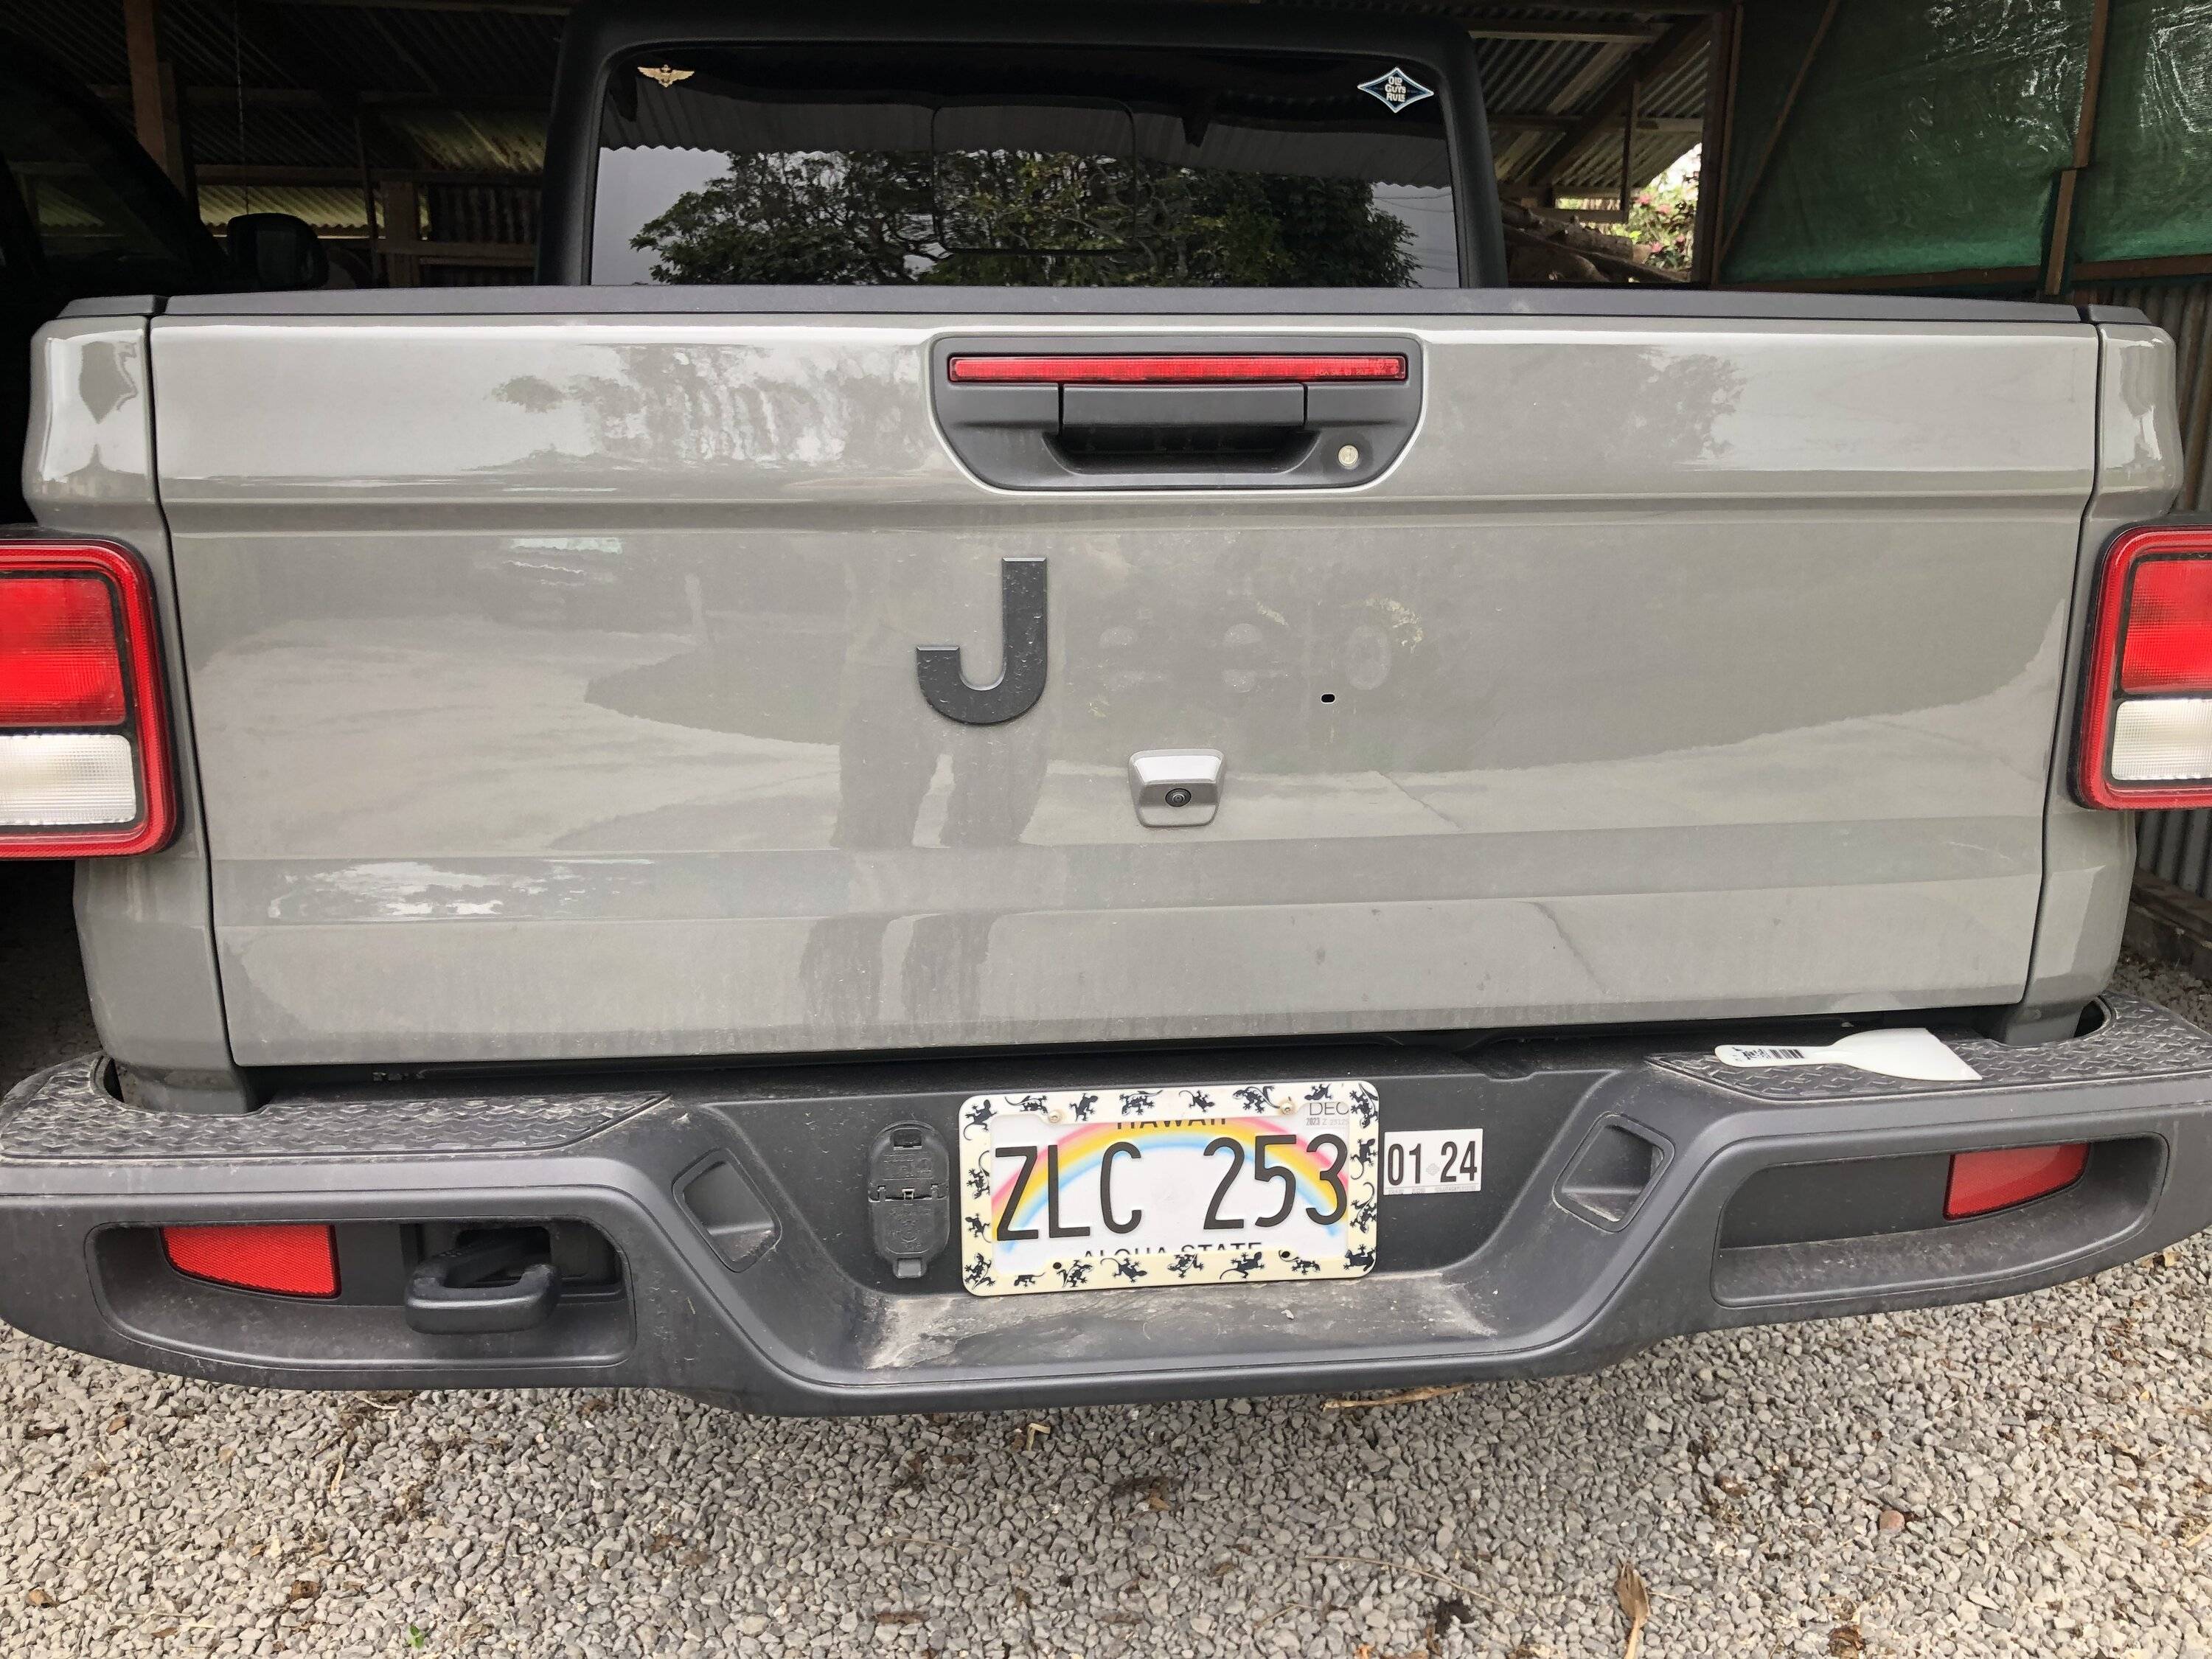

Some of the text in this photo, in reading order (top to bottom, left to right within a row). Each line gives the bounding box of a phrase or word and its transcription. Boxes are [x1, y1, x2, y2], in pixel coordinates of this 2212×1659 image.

[1385, 84, 1406, 94] GUYS
[1388, 76, 1402, 86] OLD
[917, 557, 1048, 726] J
[1310, 1102, 1349, 1116] DEC
[1388, 1141, 1478, 1186] 01 24
[995, 1141, 1142, 1241] ZLC
[1203, 1133, 1348, 1230] 253
